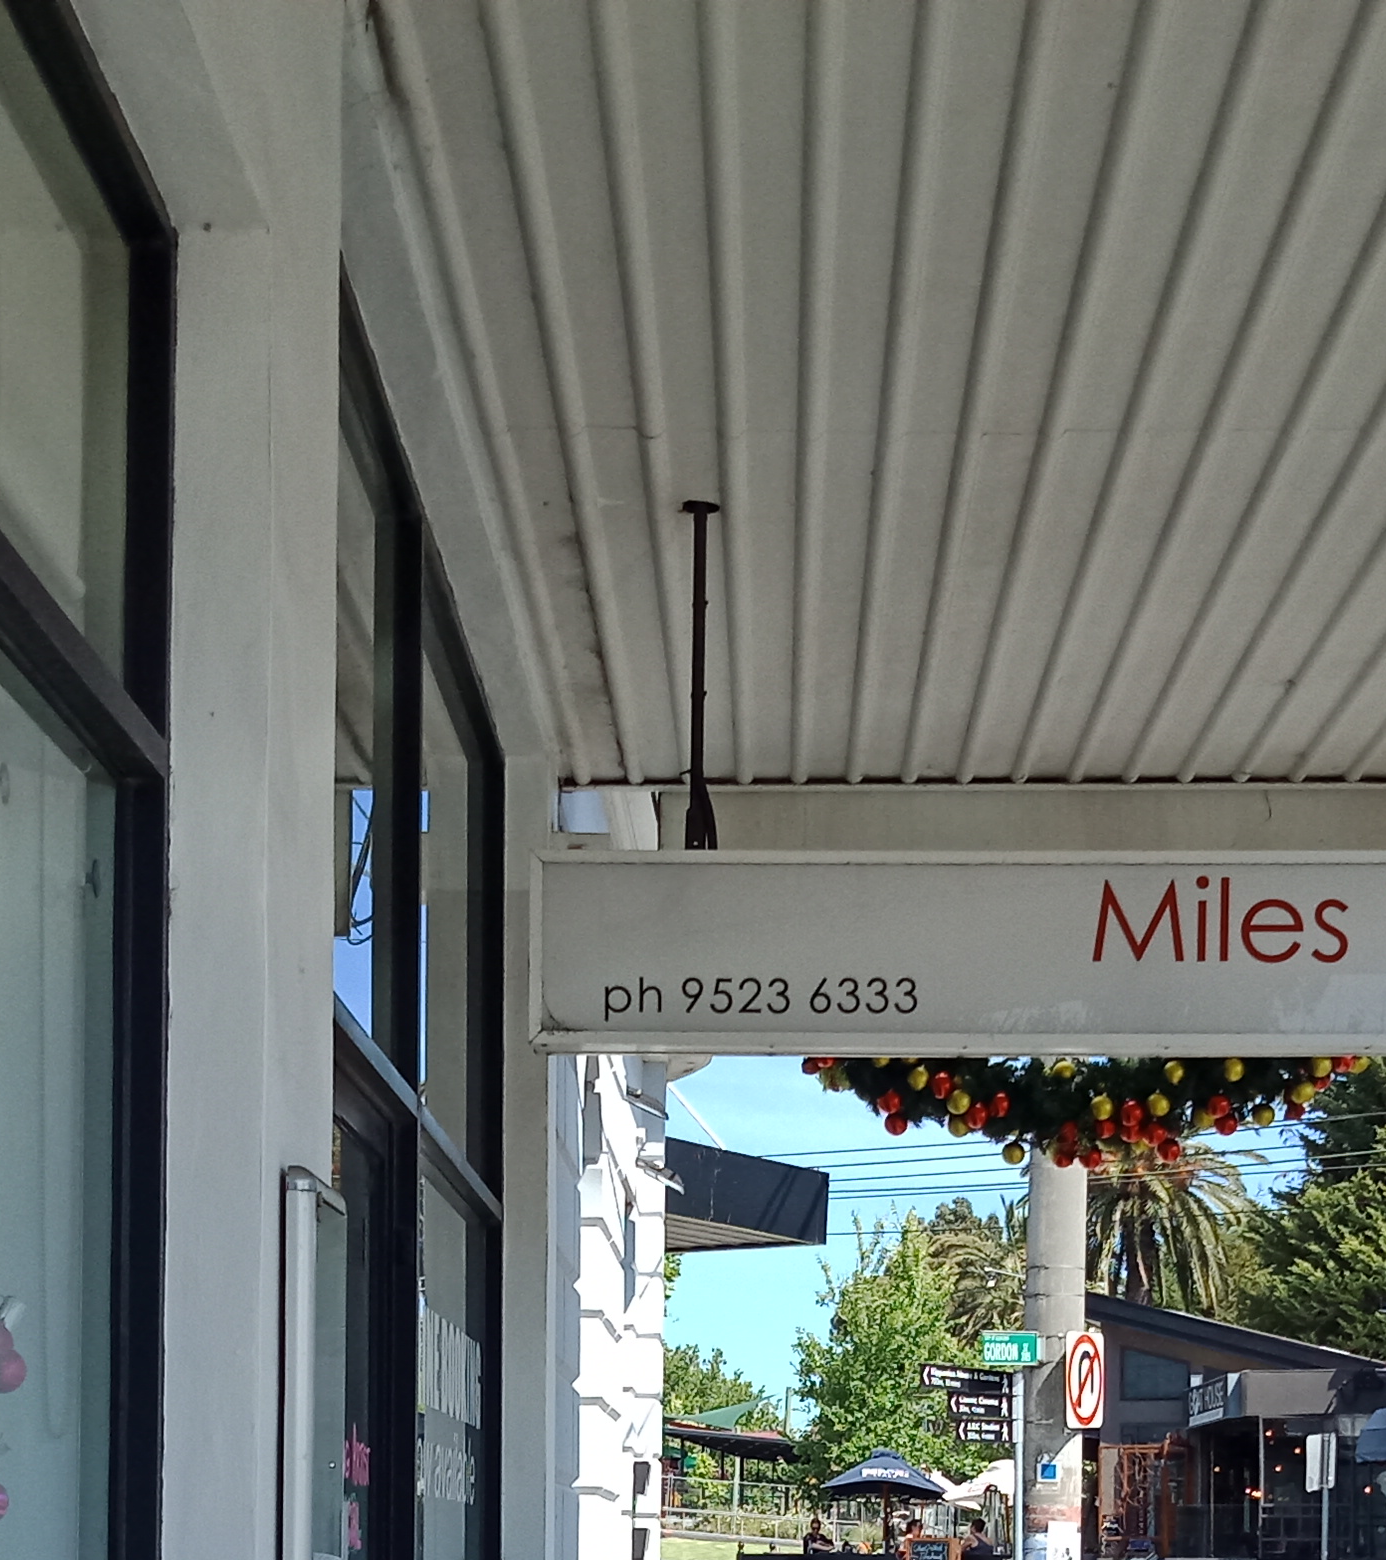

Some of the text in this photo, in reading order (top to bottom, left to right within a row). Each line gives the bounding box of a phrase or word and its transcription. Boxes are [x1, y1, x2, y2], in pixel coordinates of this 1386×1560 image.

[1092, 876, 1349, 964] Miles
[603, 977, 919, 1022] ph 9523 6333
[984, 1343, 1018, 1361] GORDON
